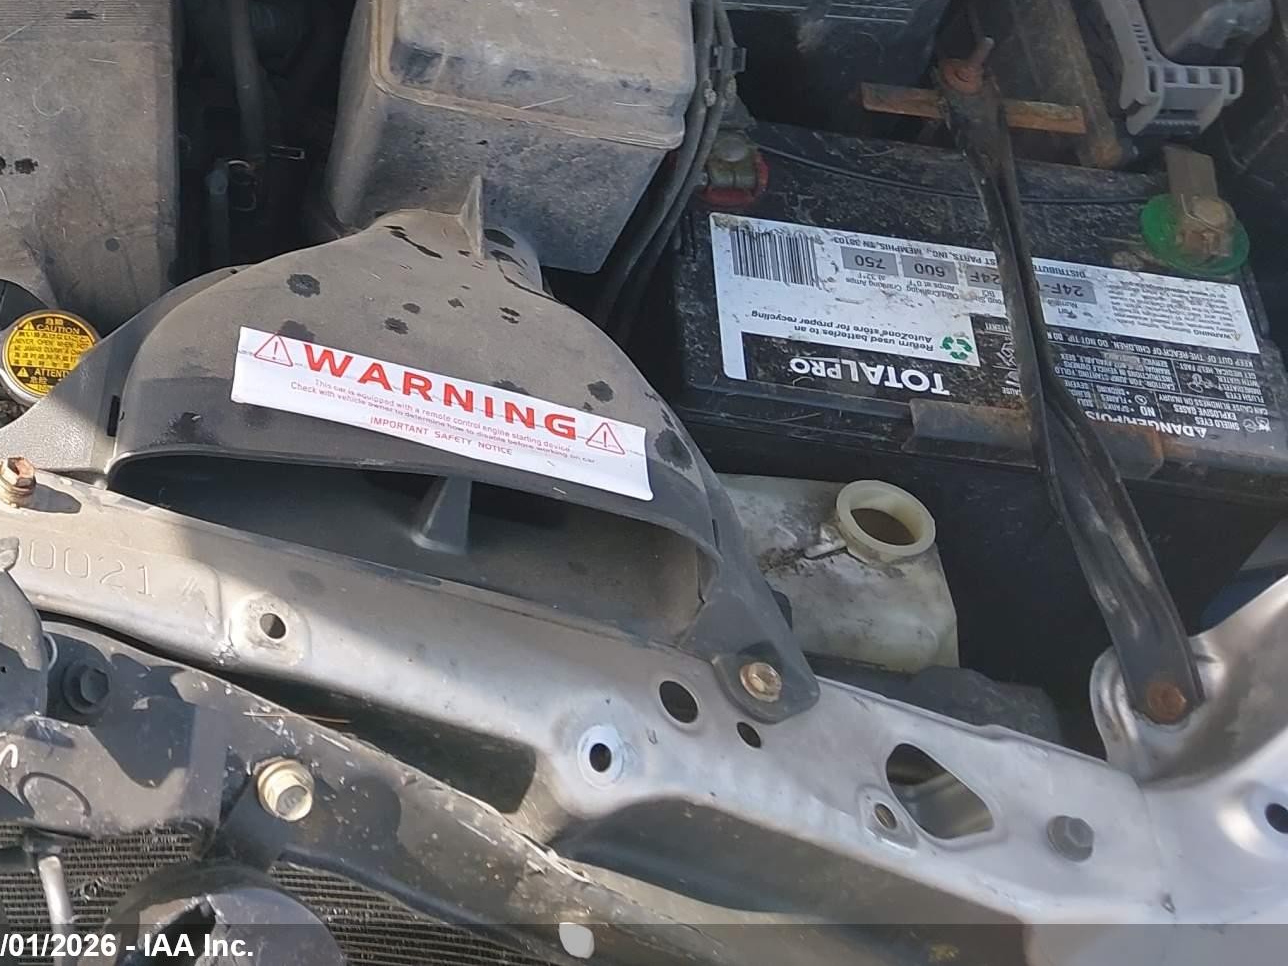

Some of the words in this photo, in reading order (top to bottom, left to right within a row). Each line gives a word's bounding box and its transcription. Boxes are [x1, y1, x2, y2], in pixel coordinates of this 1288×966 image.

[854, 254, 886, 269] 750
[948, 251, 981, 263] PARTS,
[913, 262, 945, 277] 600
[845, 277, 866, 285] Amps
[969, 271, 1000, 284] 24F
[868, 281, 901, 291] Cranking
[933, 282, 954, 291] Amps
[1043, 281, 1083, 296] 24F-
[750, 309, 797, 324] recycling
[798, 315, 833, 328] proper
[37, 324, 80, 334] CAUTION
[793, 324, 806, 332] an
[808, 326, 819, 334] to
[836, 322, 850, 331] for
[852, 325, 879, 335] store
[822, 328, 867, 341] batteries
[1052, 332, 1063, 340] DO
[870, 335, 895, 345] used
[1080, 336, 1096, 345] NOT
[1097, 338, 1108, 347] DO
[898, 340, 933, 351] Return
[1150, 346, 1162, 354] OF
[1163, 347, 1188, 358] REACH
[1188, 351, 1203, 360] THE
[1206, 353, 1216, 362] OF
[1216, 355, 1233, 364] OUT
[1233, 358, 1253, 367] KEEP
[788, 356, 949, 395] TOTALPRO
[1126, 370, 1173, 382] INSTRUCTIONS
[304, 343, 579, 441] WARNING
[1157, 392, 1182, 402] INJURY
[1193, 397, 1230, 409] BLINDNESS
[1242, 393, 1264, 403] FLUSH
[315, 378, 331, 388] This
[356, 392, 394, 407] equipped
[395, 401, 413, 411] with
[421, 409, 451, 422] remote
[452, 417, 481, 429] control
[481, 425, 510, 437] engine
[510, 432, 542, 445] starting
[1139, 405, 1156, 417] NO
[1172, 403, 1197, 414] GASES
[1197, 407, 1236, 420] EXPLOSIVE
[289, 381, 316, 394] Check
[317, 388, 335, 398] with
[335, 393, 366, 406] vehicle
[367, 402, 393, 412] owner
[403, 411, 445, 427] determine
[446, 423, 464, 432] how
[475, 431, 506, 443] disable
[506, 439, 534, 450] before
[535, 445, 568, 458] working
[1194, 416, 1213, 425] EYES
[1213, 419, 1240, 429] SHIELD
[369, 414, 429, 437] IMPORTANT
[432, 429, 472, 446] SAFETY
[477, 441, 513, 455] NOTICE
